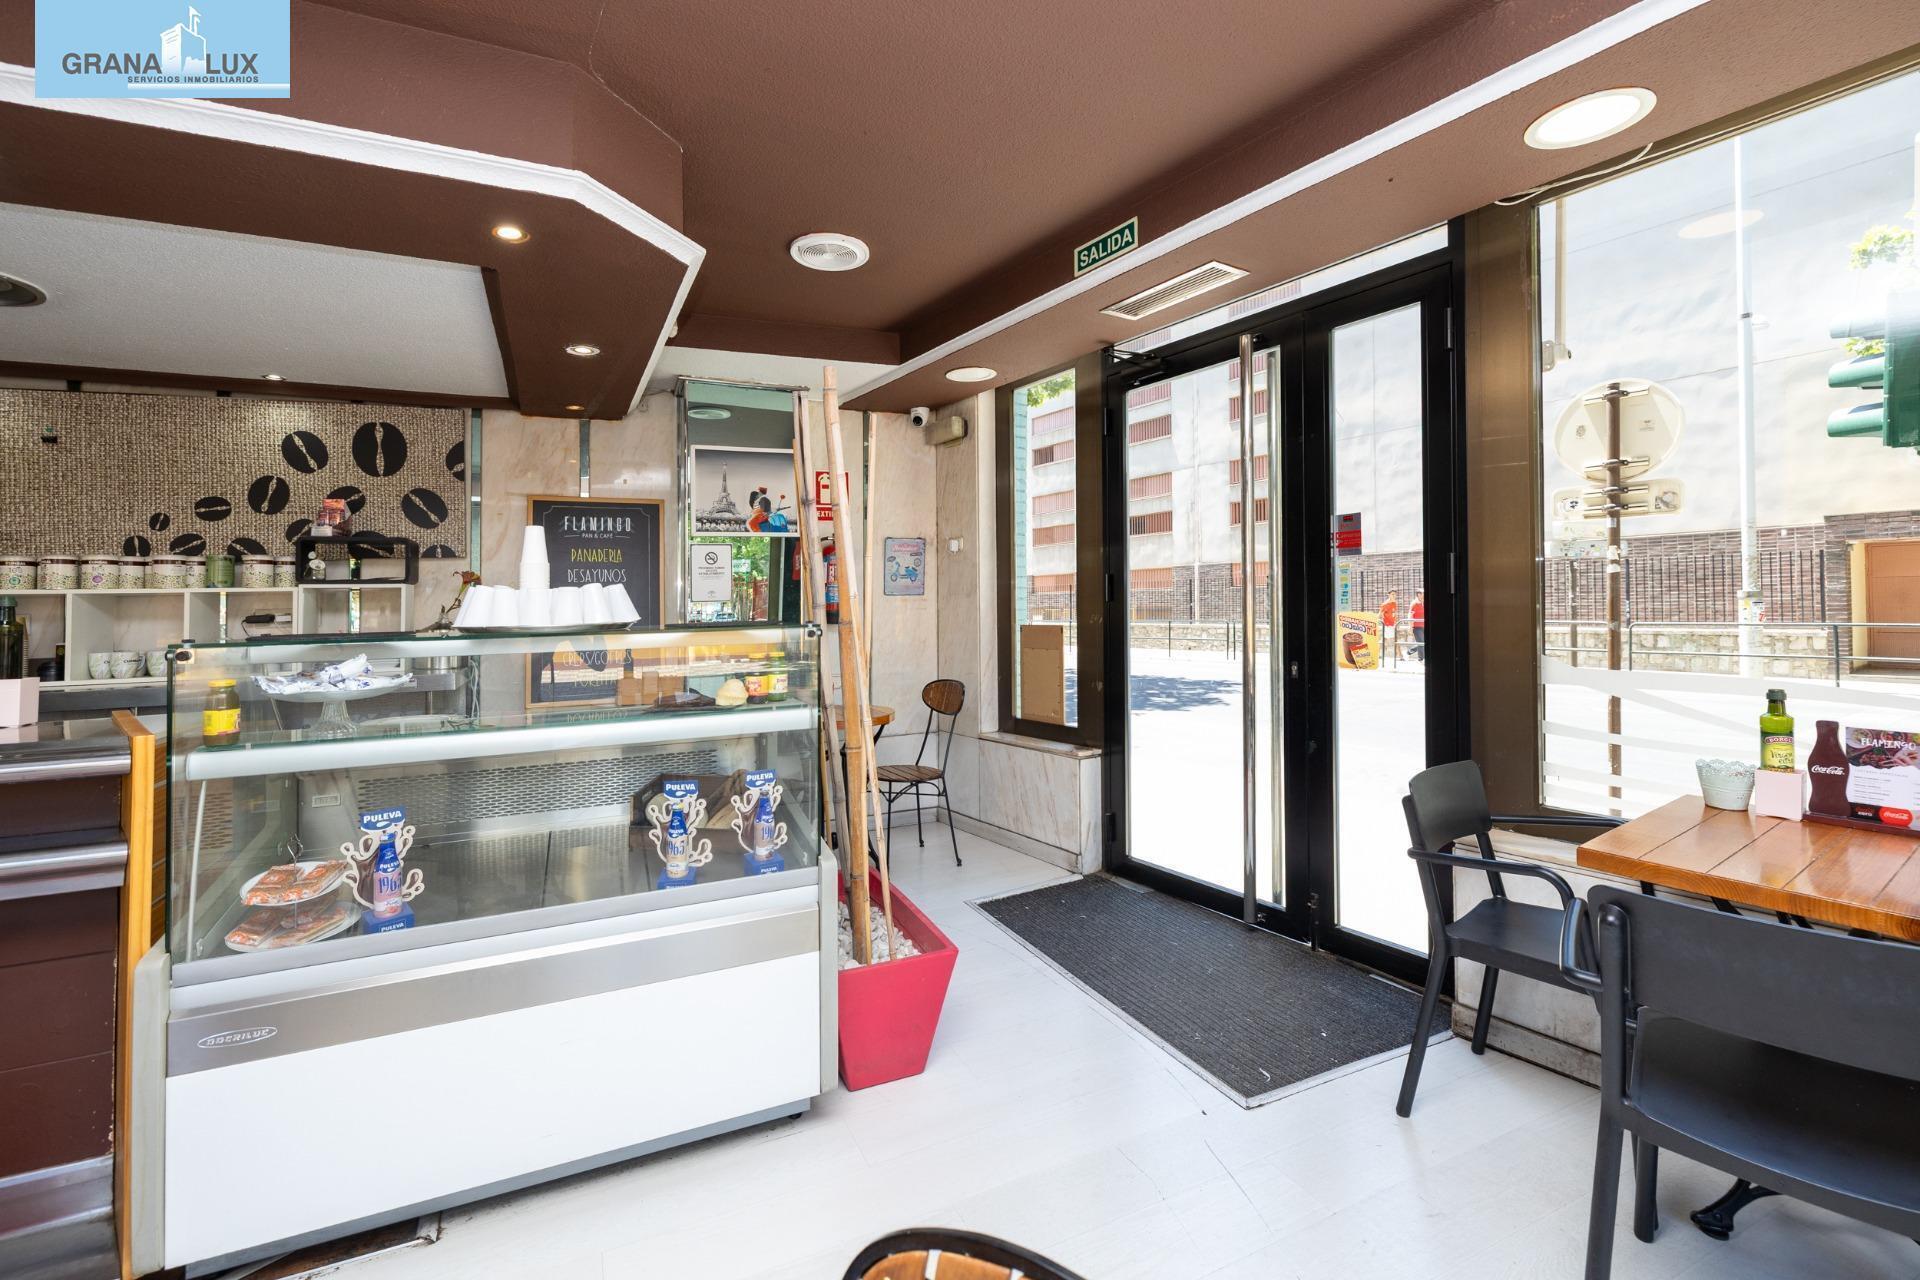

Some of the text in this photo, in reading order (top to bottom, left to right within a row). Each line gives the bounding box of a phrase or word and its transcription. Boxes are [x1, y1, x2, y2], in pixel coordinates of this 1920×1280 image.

[1079, 228, 1133, 267] SALIDA
[817, 509, 833, 518] EXTI
[564, 516, 632, 532] FLAMINGO
[567, 568, 628, 584] DESAYUNOS
[746, 772, 774, 781] PULEVA
[1811, 764, 1845, 776] Coca-Cola
[665, 783, 696, 791] PULEVA
[363, 810, 402, 824] PULEVA
